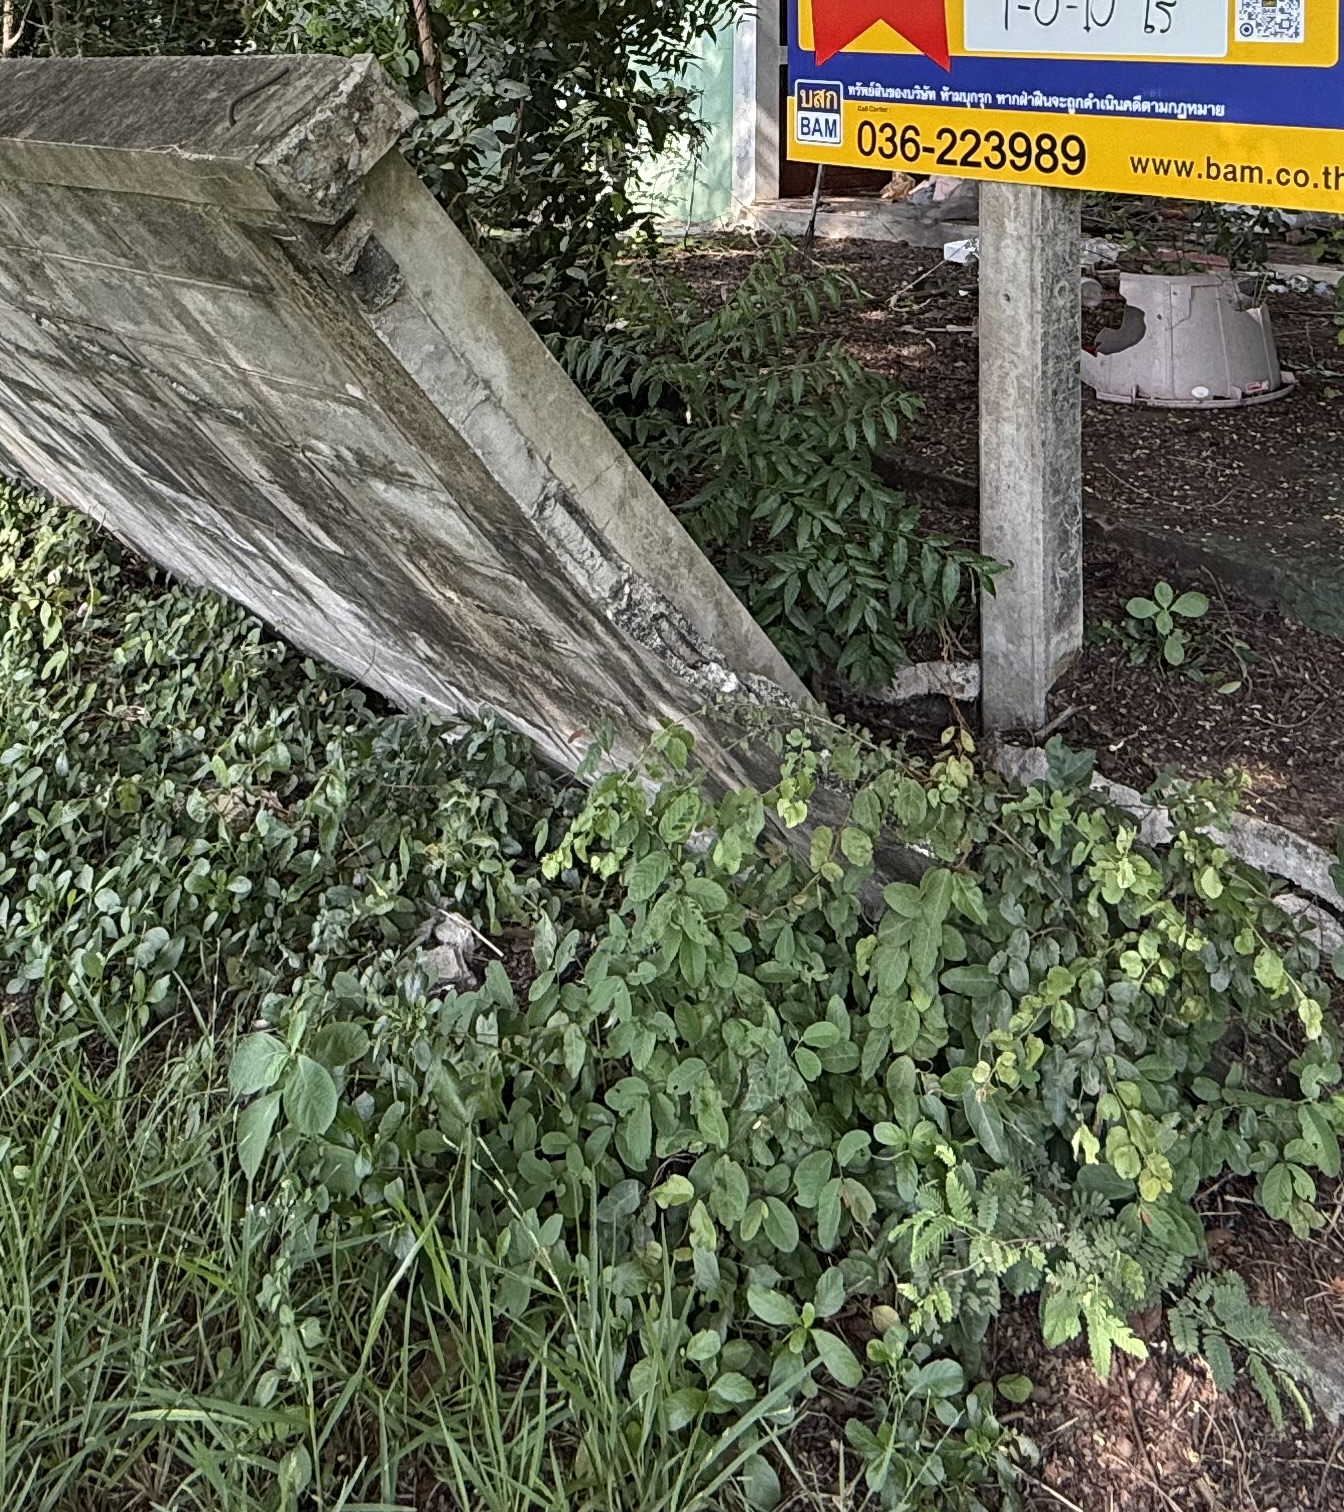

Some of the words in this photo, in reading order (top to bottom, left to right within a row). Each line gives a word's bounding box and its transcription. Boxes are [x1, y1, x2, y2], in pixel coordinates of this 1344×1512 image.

[799, 88, 838, 110] บสก
[847, 81, 937, 101] ทรัพย์สินของบริษัท
[939, 86, 992, 109] ห้ามบุกรุก
[995, 90, 1226, 120] หากฝ่าฝืนจะถูกดำเนินคดีตามกฎหมาย
[800, 116, 838, 139] BAM
[857, 119, 1087, 176] 036-223989
